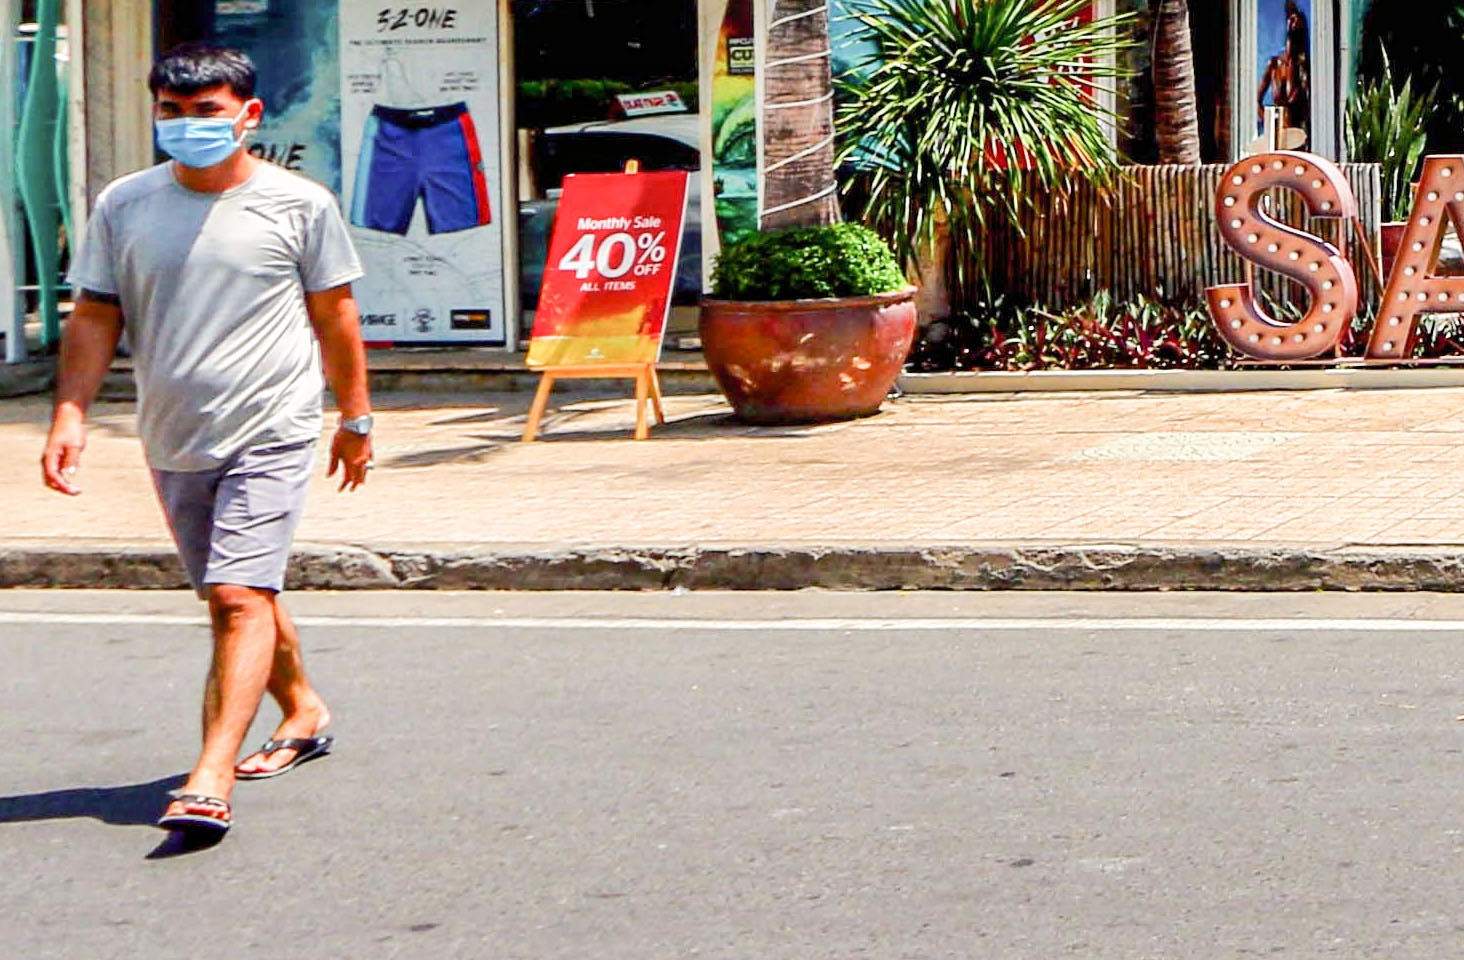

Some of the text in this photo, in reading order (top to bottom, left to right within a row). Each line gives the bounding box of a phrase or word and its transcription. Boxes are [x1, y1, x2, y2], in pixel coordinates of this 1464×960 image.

[732, 49, 754, 61] CU
[577, 216, 662, 231] Monthly Sale
[558, 231, 666, 279] 40%
[633, 263, 662, 277] OFF
[580, 280, 637, 292] ALL ITEMS
